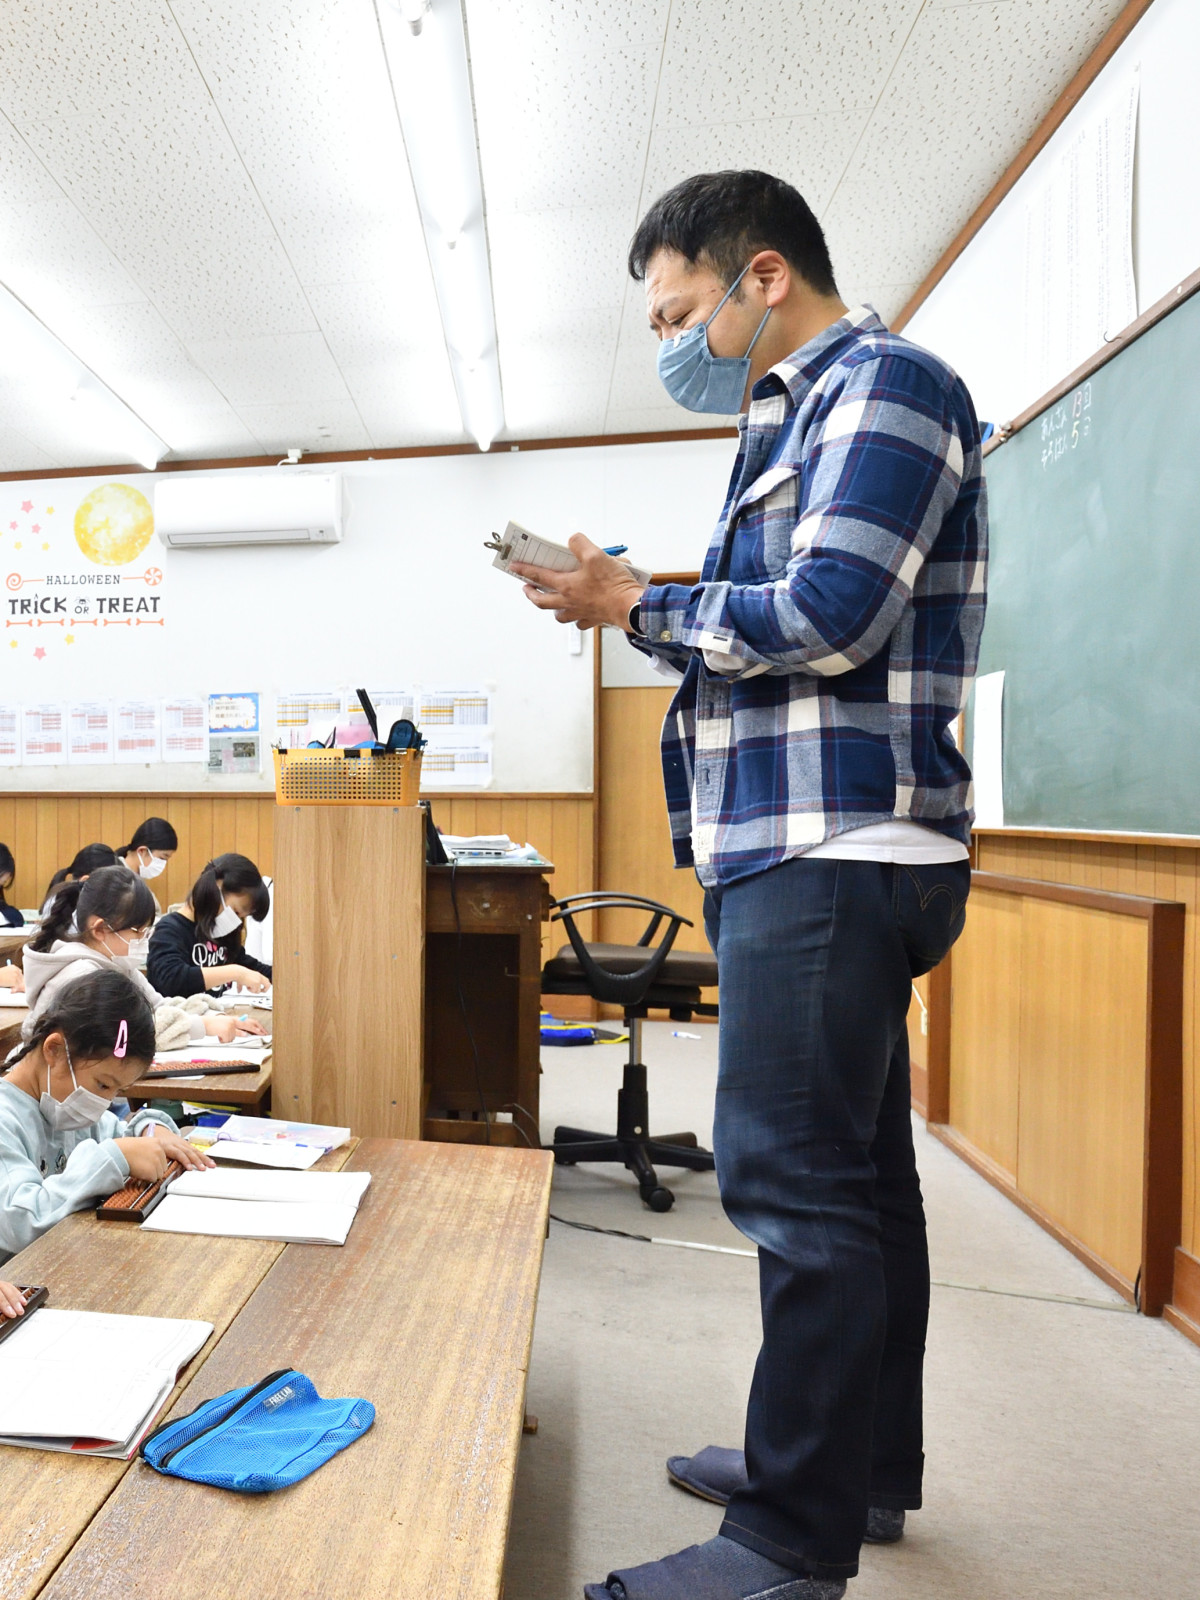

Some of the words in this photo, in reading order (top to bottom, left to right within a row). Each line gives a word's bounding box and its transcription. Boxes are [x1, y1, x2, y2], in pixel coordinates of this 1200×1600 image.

[46, 574, 121, 585] HALLOWEEN
[74, 605, 89, 615] OR
[96, 596, 161, 614] TREAT
